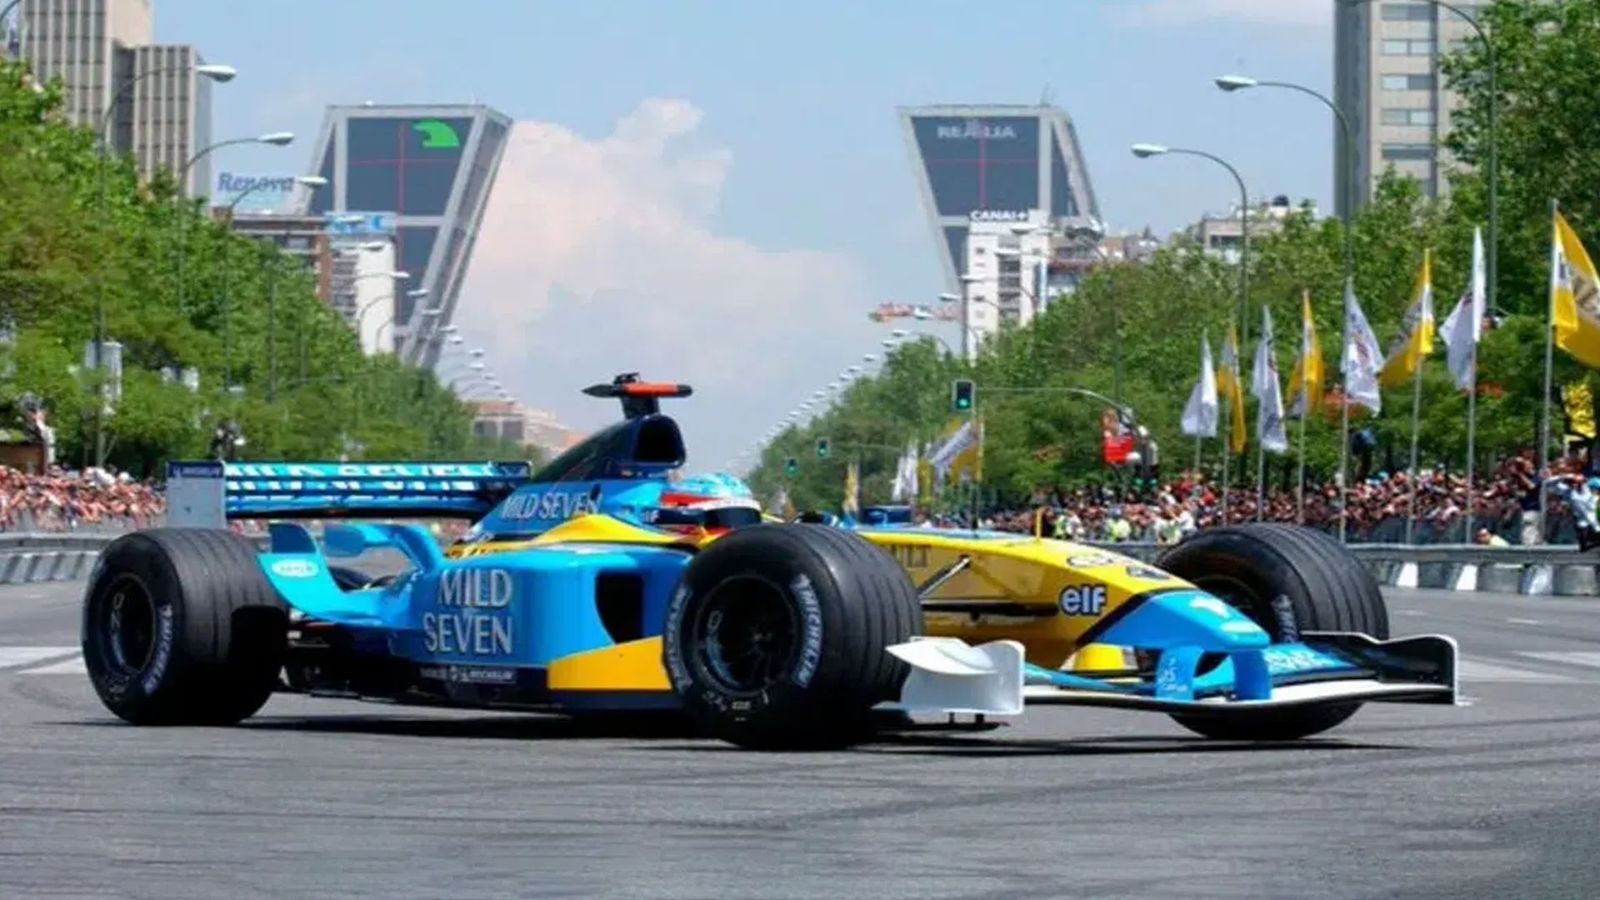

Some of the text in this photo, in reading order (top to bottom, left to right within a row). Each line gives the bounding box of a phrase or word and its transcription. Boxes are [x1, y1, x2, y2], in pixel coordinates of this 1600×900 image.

[937, 124, 1018, 139] REALIA
[217, 171, 295, 193] Renova
[501, 491, 602, 520] MILD SEVEN
[439, 568, 513, 607] MILD
[1060, 584, 1107, 615] elf
[423, 611, 513, 655] SEVEN
[799, 589, 823, 687] MICHELIN
